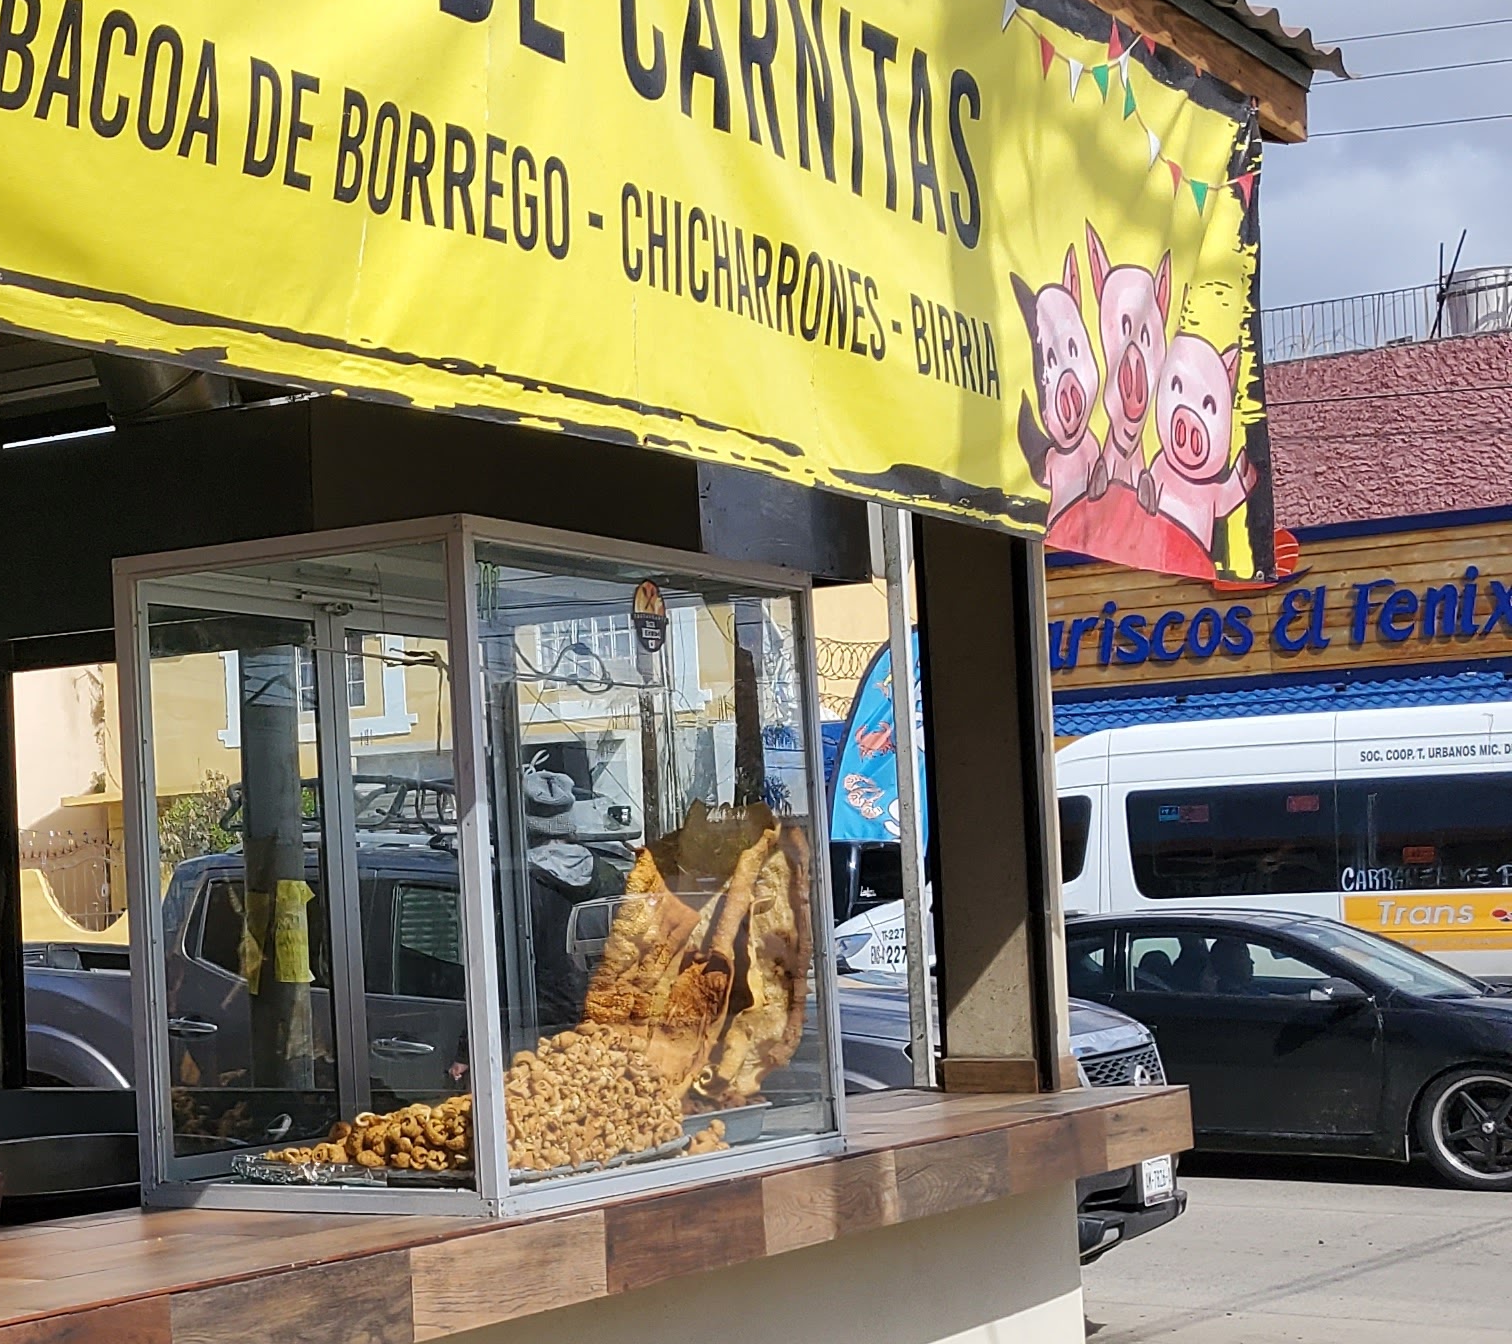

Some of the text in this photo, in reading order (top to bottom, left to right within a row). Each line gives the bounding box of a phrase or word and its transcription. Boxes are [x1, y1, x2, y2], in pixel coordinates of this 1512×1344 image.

[242, 55, 322, 190] DE
[333, 87, 571, 261] BORREGO
[621, 182, 886, 362] CHICHARRONES
[911, 294, 1002, 401] BIRRIA
[1048, 564, 1512, 670] ariscos El Fenix
[1360, 751, 1383, 762] SOC.
[1386, 749, 1415, 760] COOP.
[1428, 745, 1476, 758] URBANOS
[1479, 744, 1502, 756] MIC.
[1504, 743, 1512, 754] D
[1378, 900, 1475, 925] Trans
